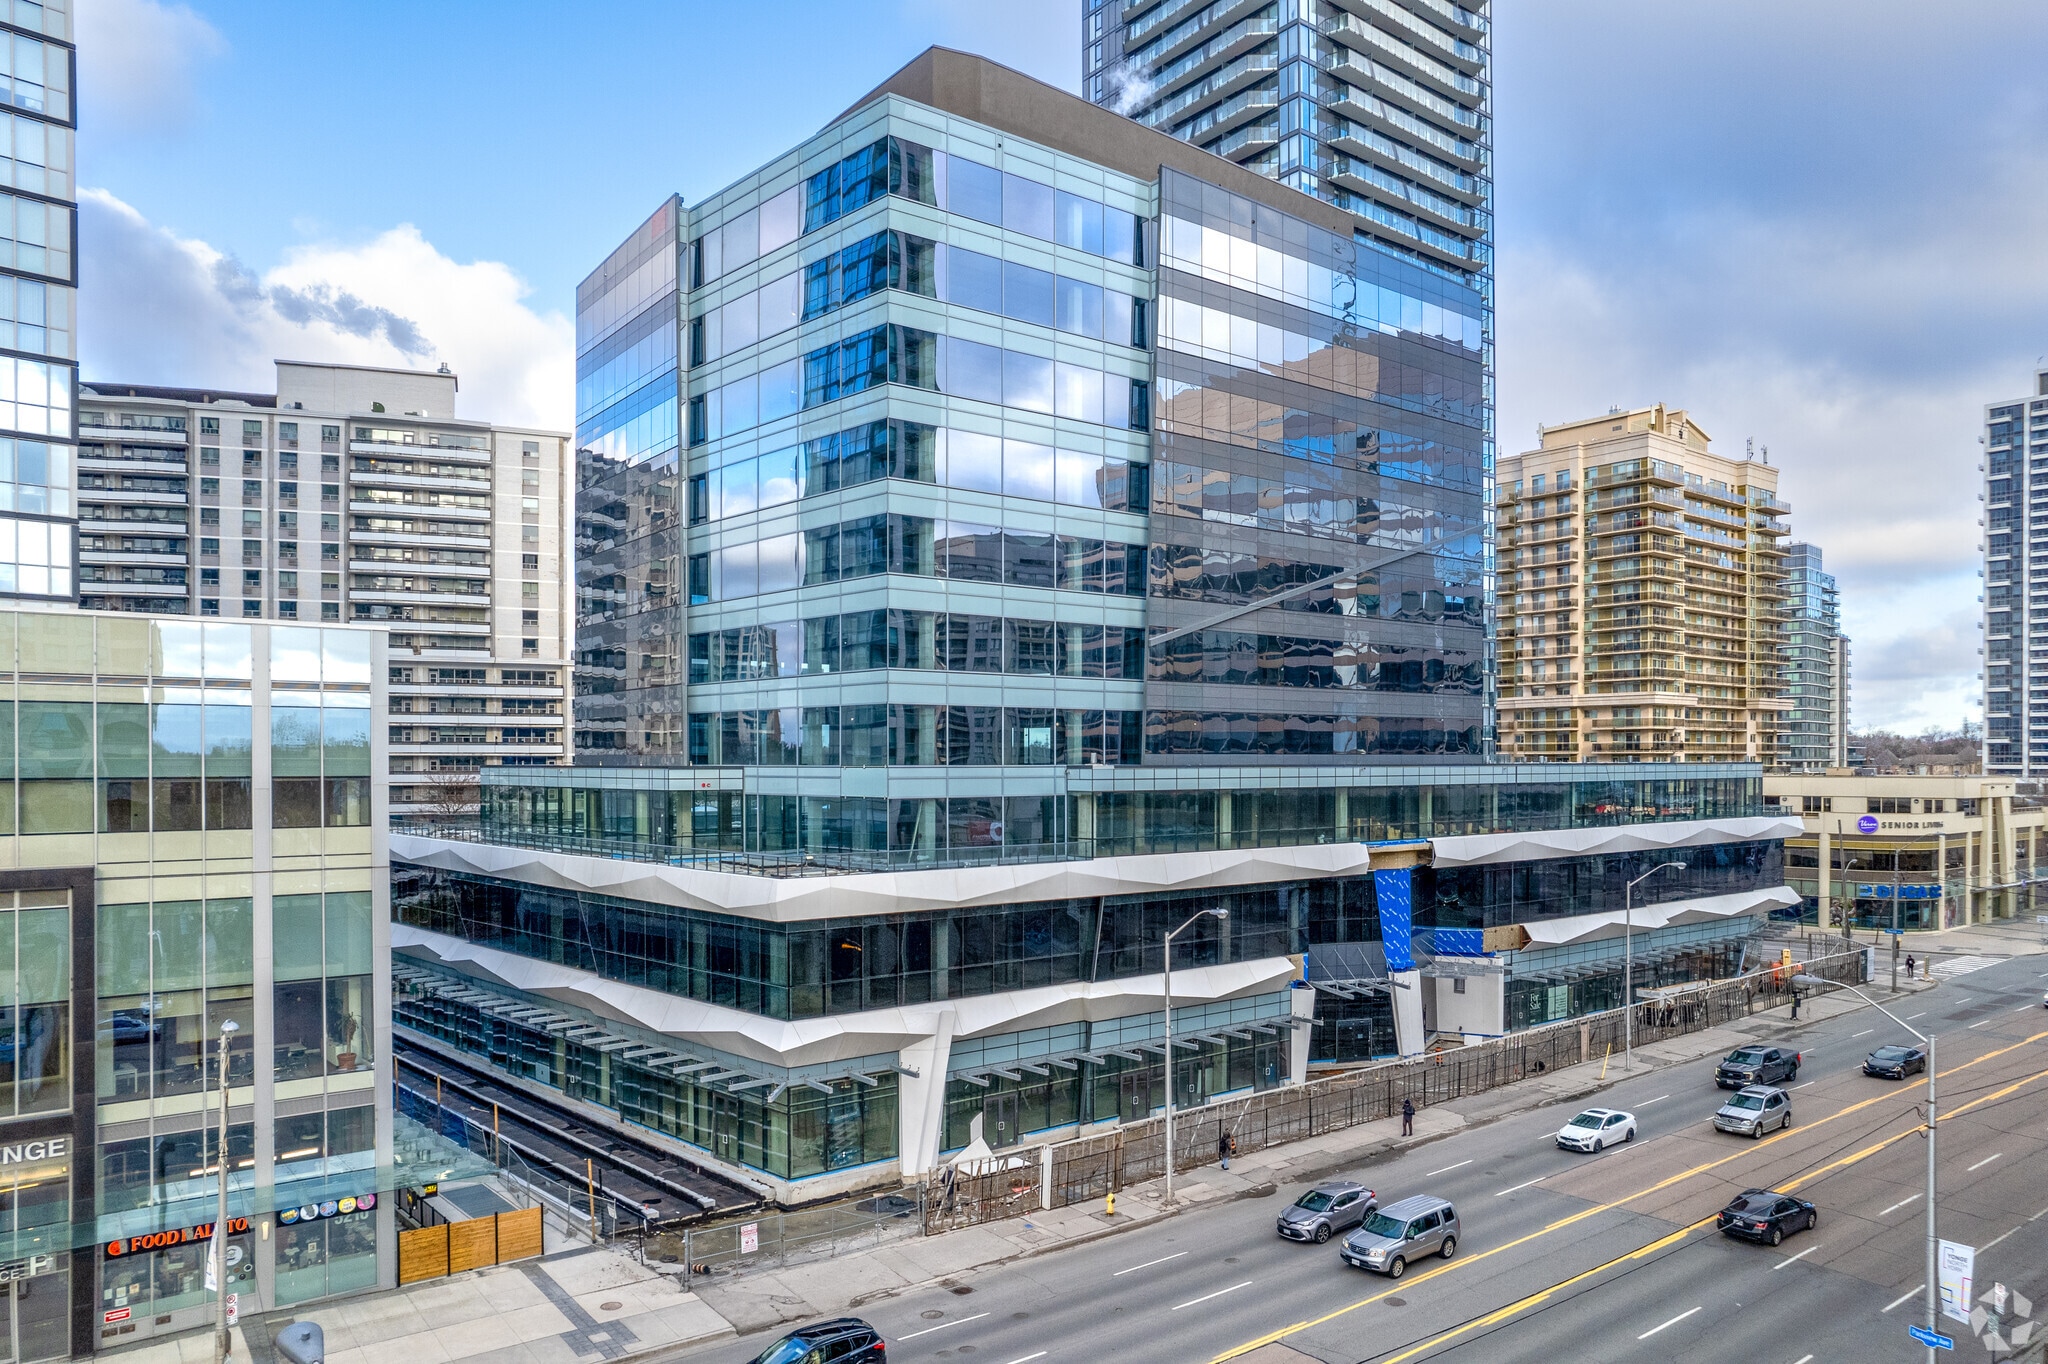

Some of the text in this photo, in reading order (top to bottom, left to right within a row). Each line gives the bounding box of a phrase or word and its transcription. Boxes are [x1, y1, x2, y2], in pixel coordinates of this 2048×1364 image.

[1881, 821, 1919, 829] SENIOR
[2, 1138, 66, 1165] NGE
[131, 1230, 180, 1252] FOOD
[1947, 1253, 1968, 1263] YONGE
